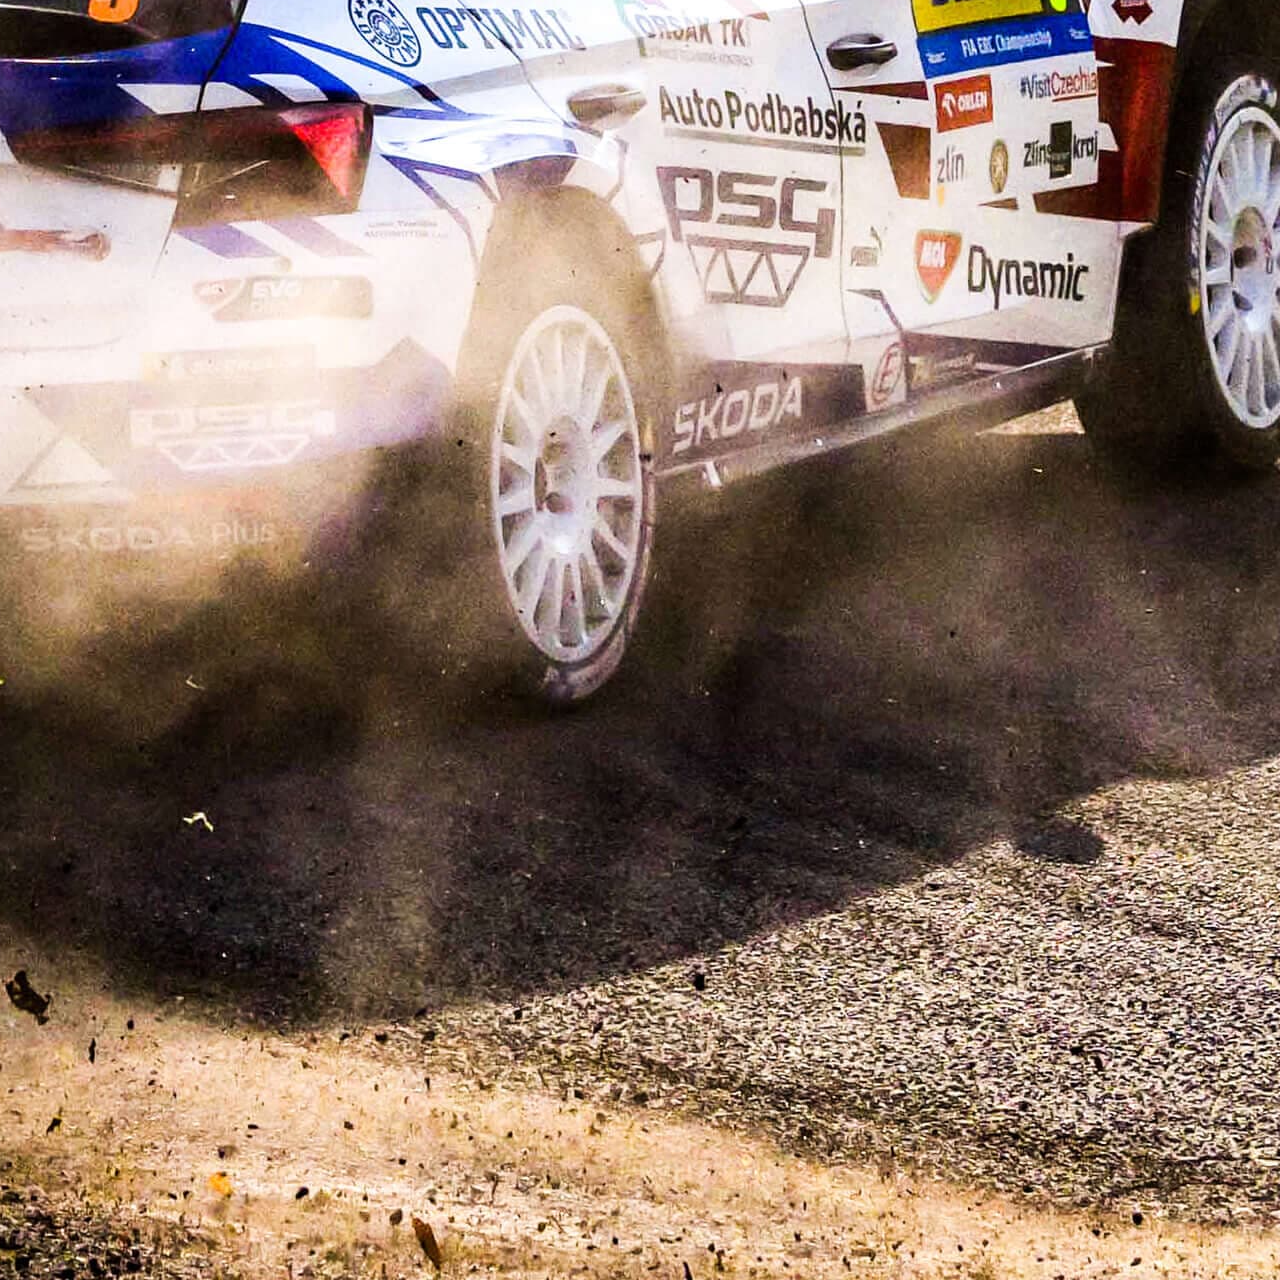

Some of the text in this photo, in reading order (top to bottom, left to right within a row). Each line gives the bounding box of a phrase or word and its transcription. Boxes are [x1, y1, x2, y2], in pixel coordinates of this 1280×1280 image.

[415, 6, 587, 51] OPTIMAL
[960, 39, 977, 59] FIA
[658, 84, 867, 144] Auto Podbabská
[957, 90, 988, 113] ORLEN
[937, 144, 965, 184] zlín
[1072, 130, 1099, 161] kraj
[967, 245, 1090, 311] Dynamic
